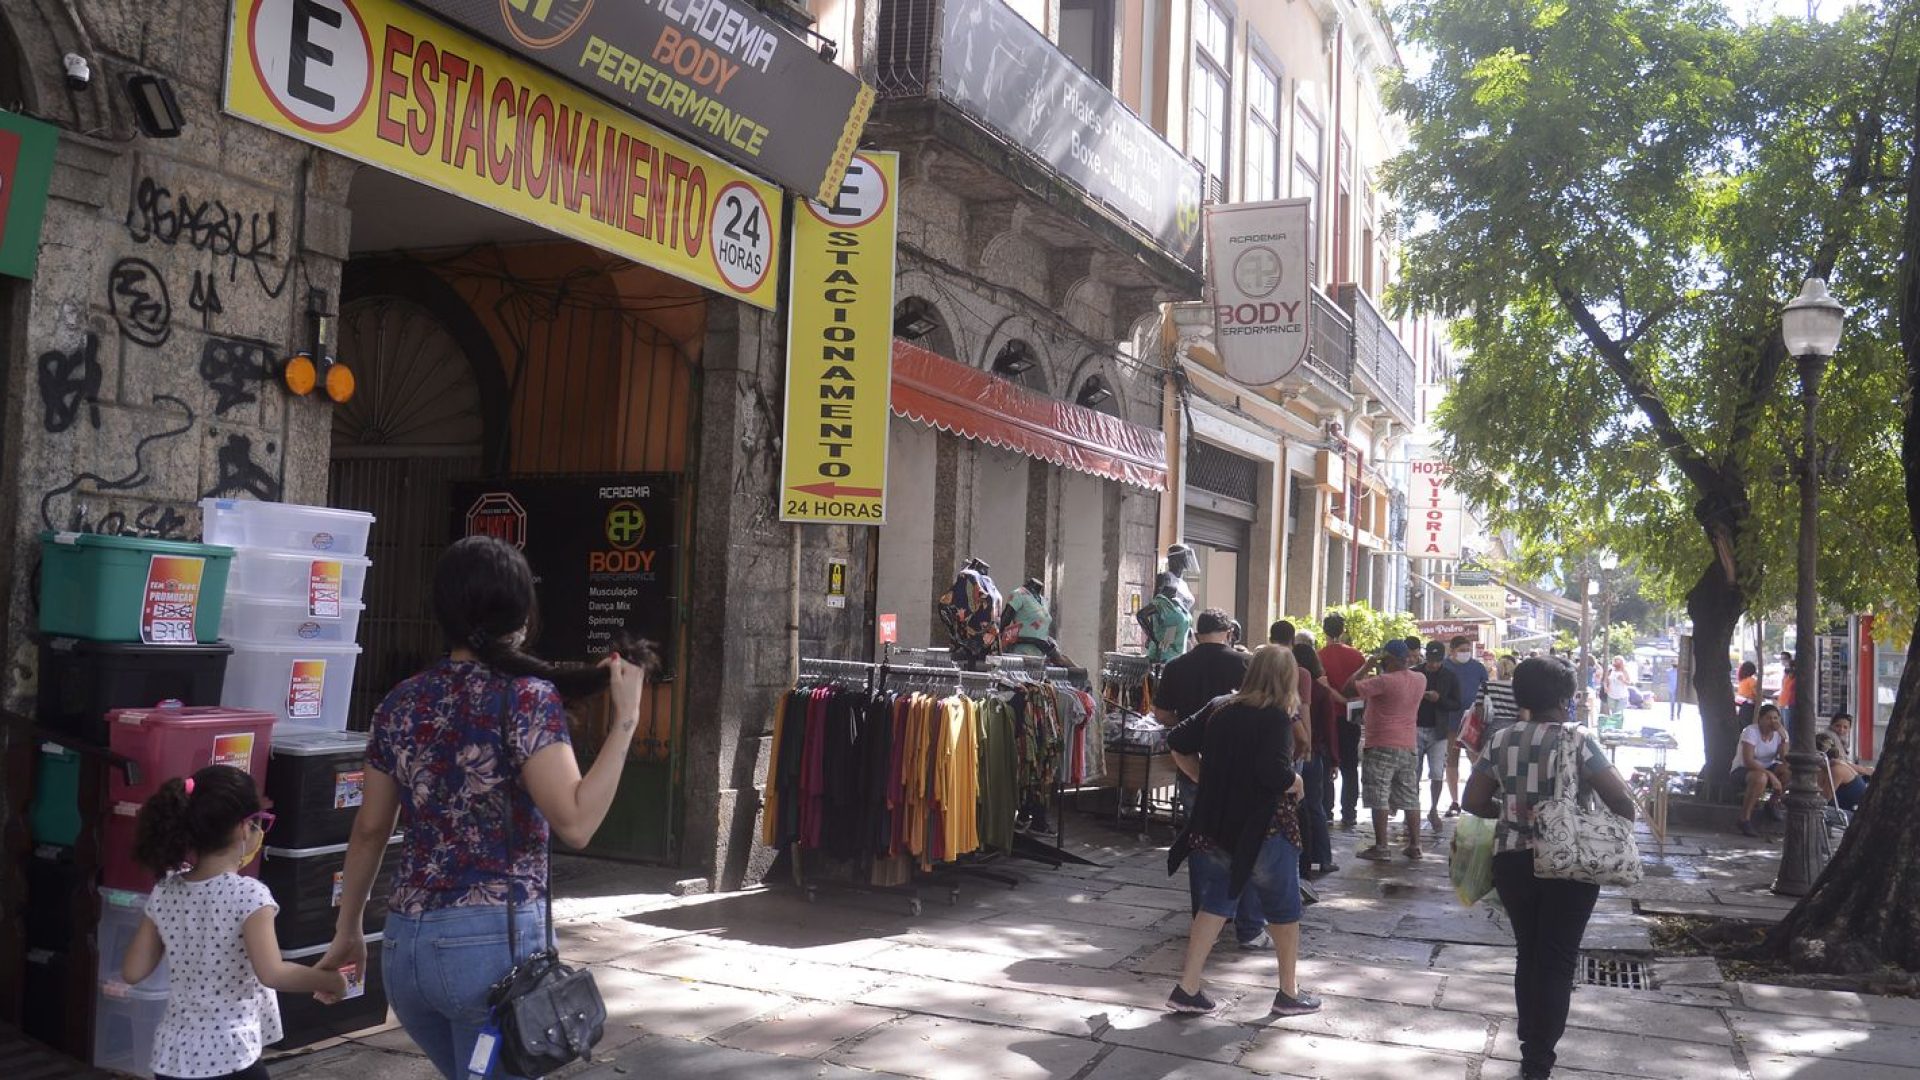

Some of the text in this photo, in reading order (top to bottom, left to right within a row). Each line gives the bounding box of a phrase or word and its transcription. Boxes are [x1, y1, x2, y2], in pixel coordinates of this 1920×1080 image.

[287, 0, 342, 112] E
[652, 25, 739, 94] BODY
[579, 35, 769, 156] PERFORMANCE
[1063, 82, 1101, 135] Pilates
[1112, 120, 1140, 169] Muay
[376, 25, 708, 258] ESTACIONAMENTO
[1071, 130, 1100, 174] Boxe
[1111, 162, 1127, 193] Jiu
[725, 195, 761, 249] 24
[1229, 233, 1287, 244] ACADEMIA
[719, 238, 762, 276] HORAS
[1218, 301, 1301, 325] BODY
[1221, 323, 1301, 336] ERFORMANCE
[599, 486, 650, 499] ACADEMIA
[787, 500, 882, 518] 24 HORAS
[1425, 478, 1443, 553] VITORIA
[589, 551, 656, 573] BODY
[589, 587, 638, 597] Musculação
[588, 601, 631, 611] Dança Mix
[588, 616, 625, 627] Spinning
[1435, 624, 1463, 634] Pedro
[587, 631, 611, 640] Jump
[587, 645, 610, 654] Local
